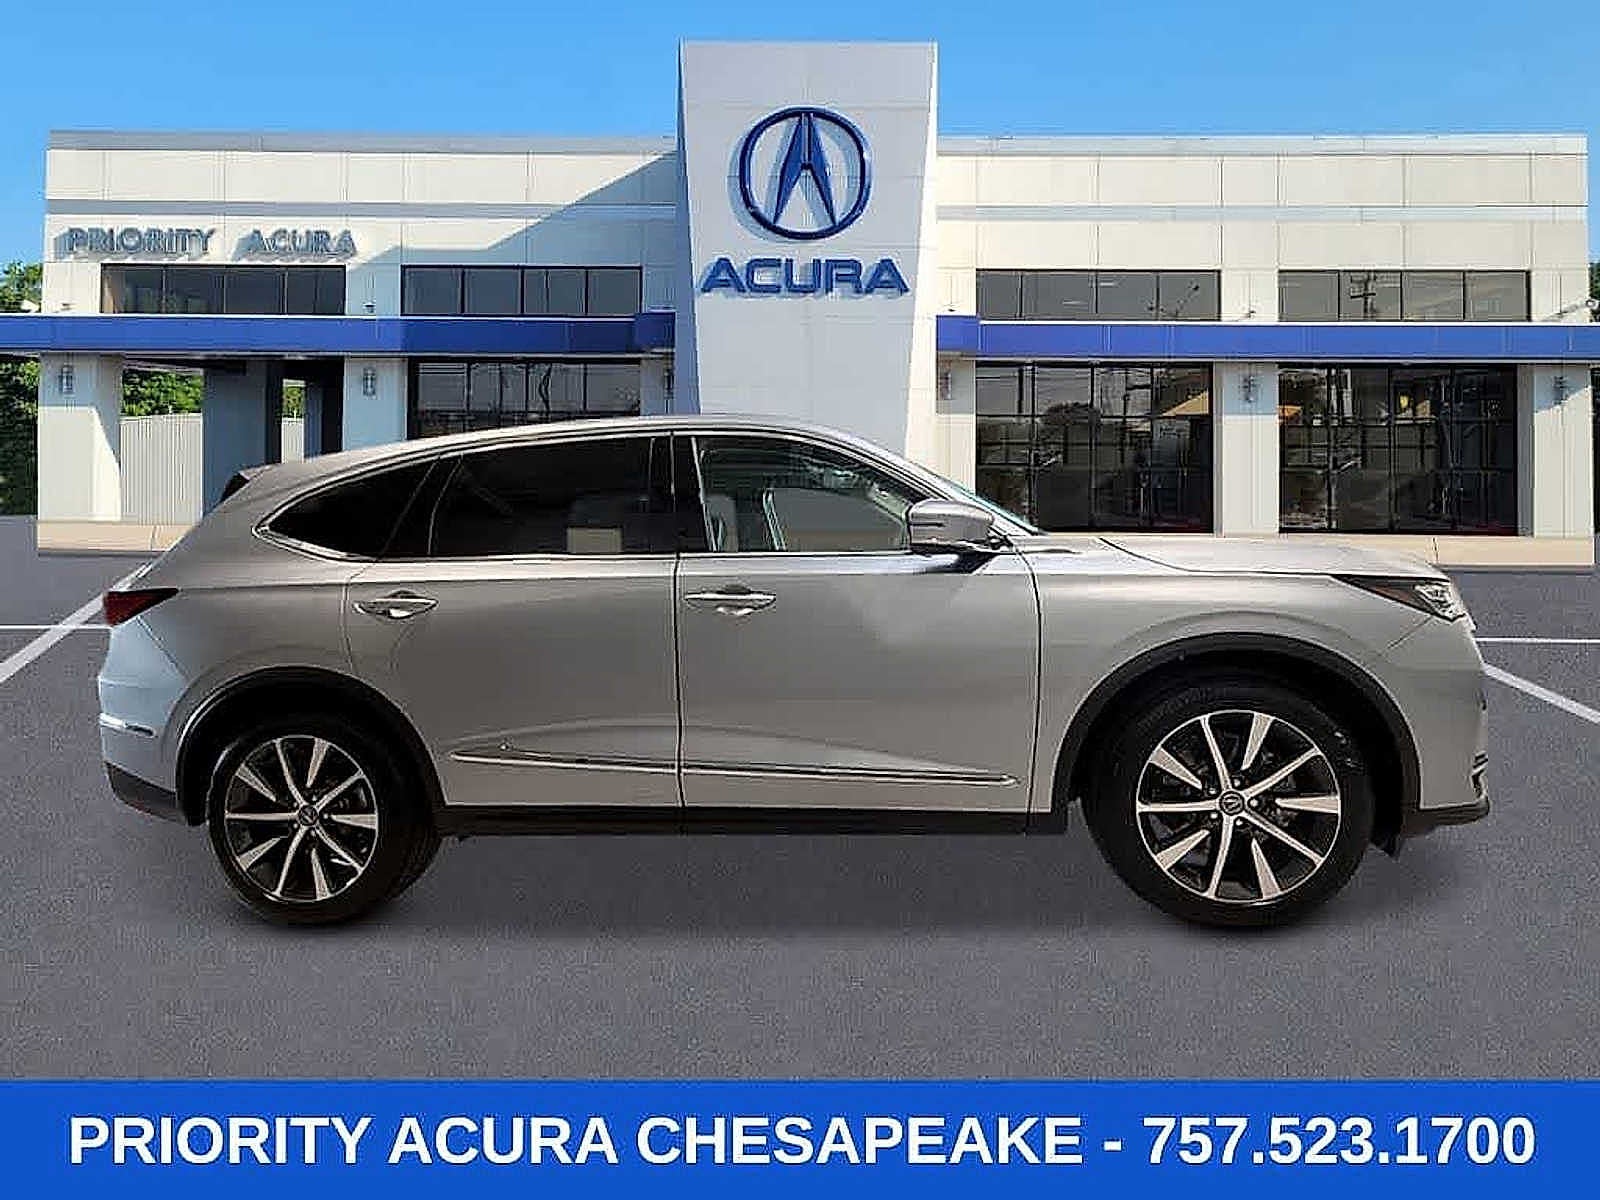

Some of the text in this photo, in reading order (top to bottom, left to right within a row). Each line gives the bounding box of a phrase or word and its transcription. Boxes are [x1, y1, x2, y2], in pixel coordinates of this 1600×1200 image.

[67, 227, 356, 255] PRIORITY ACURA
[700, 256, 909, 295] ACURA
